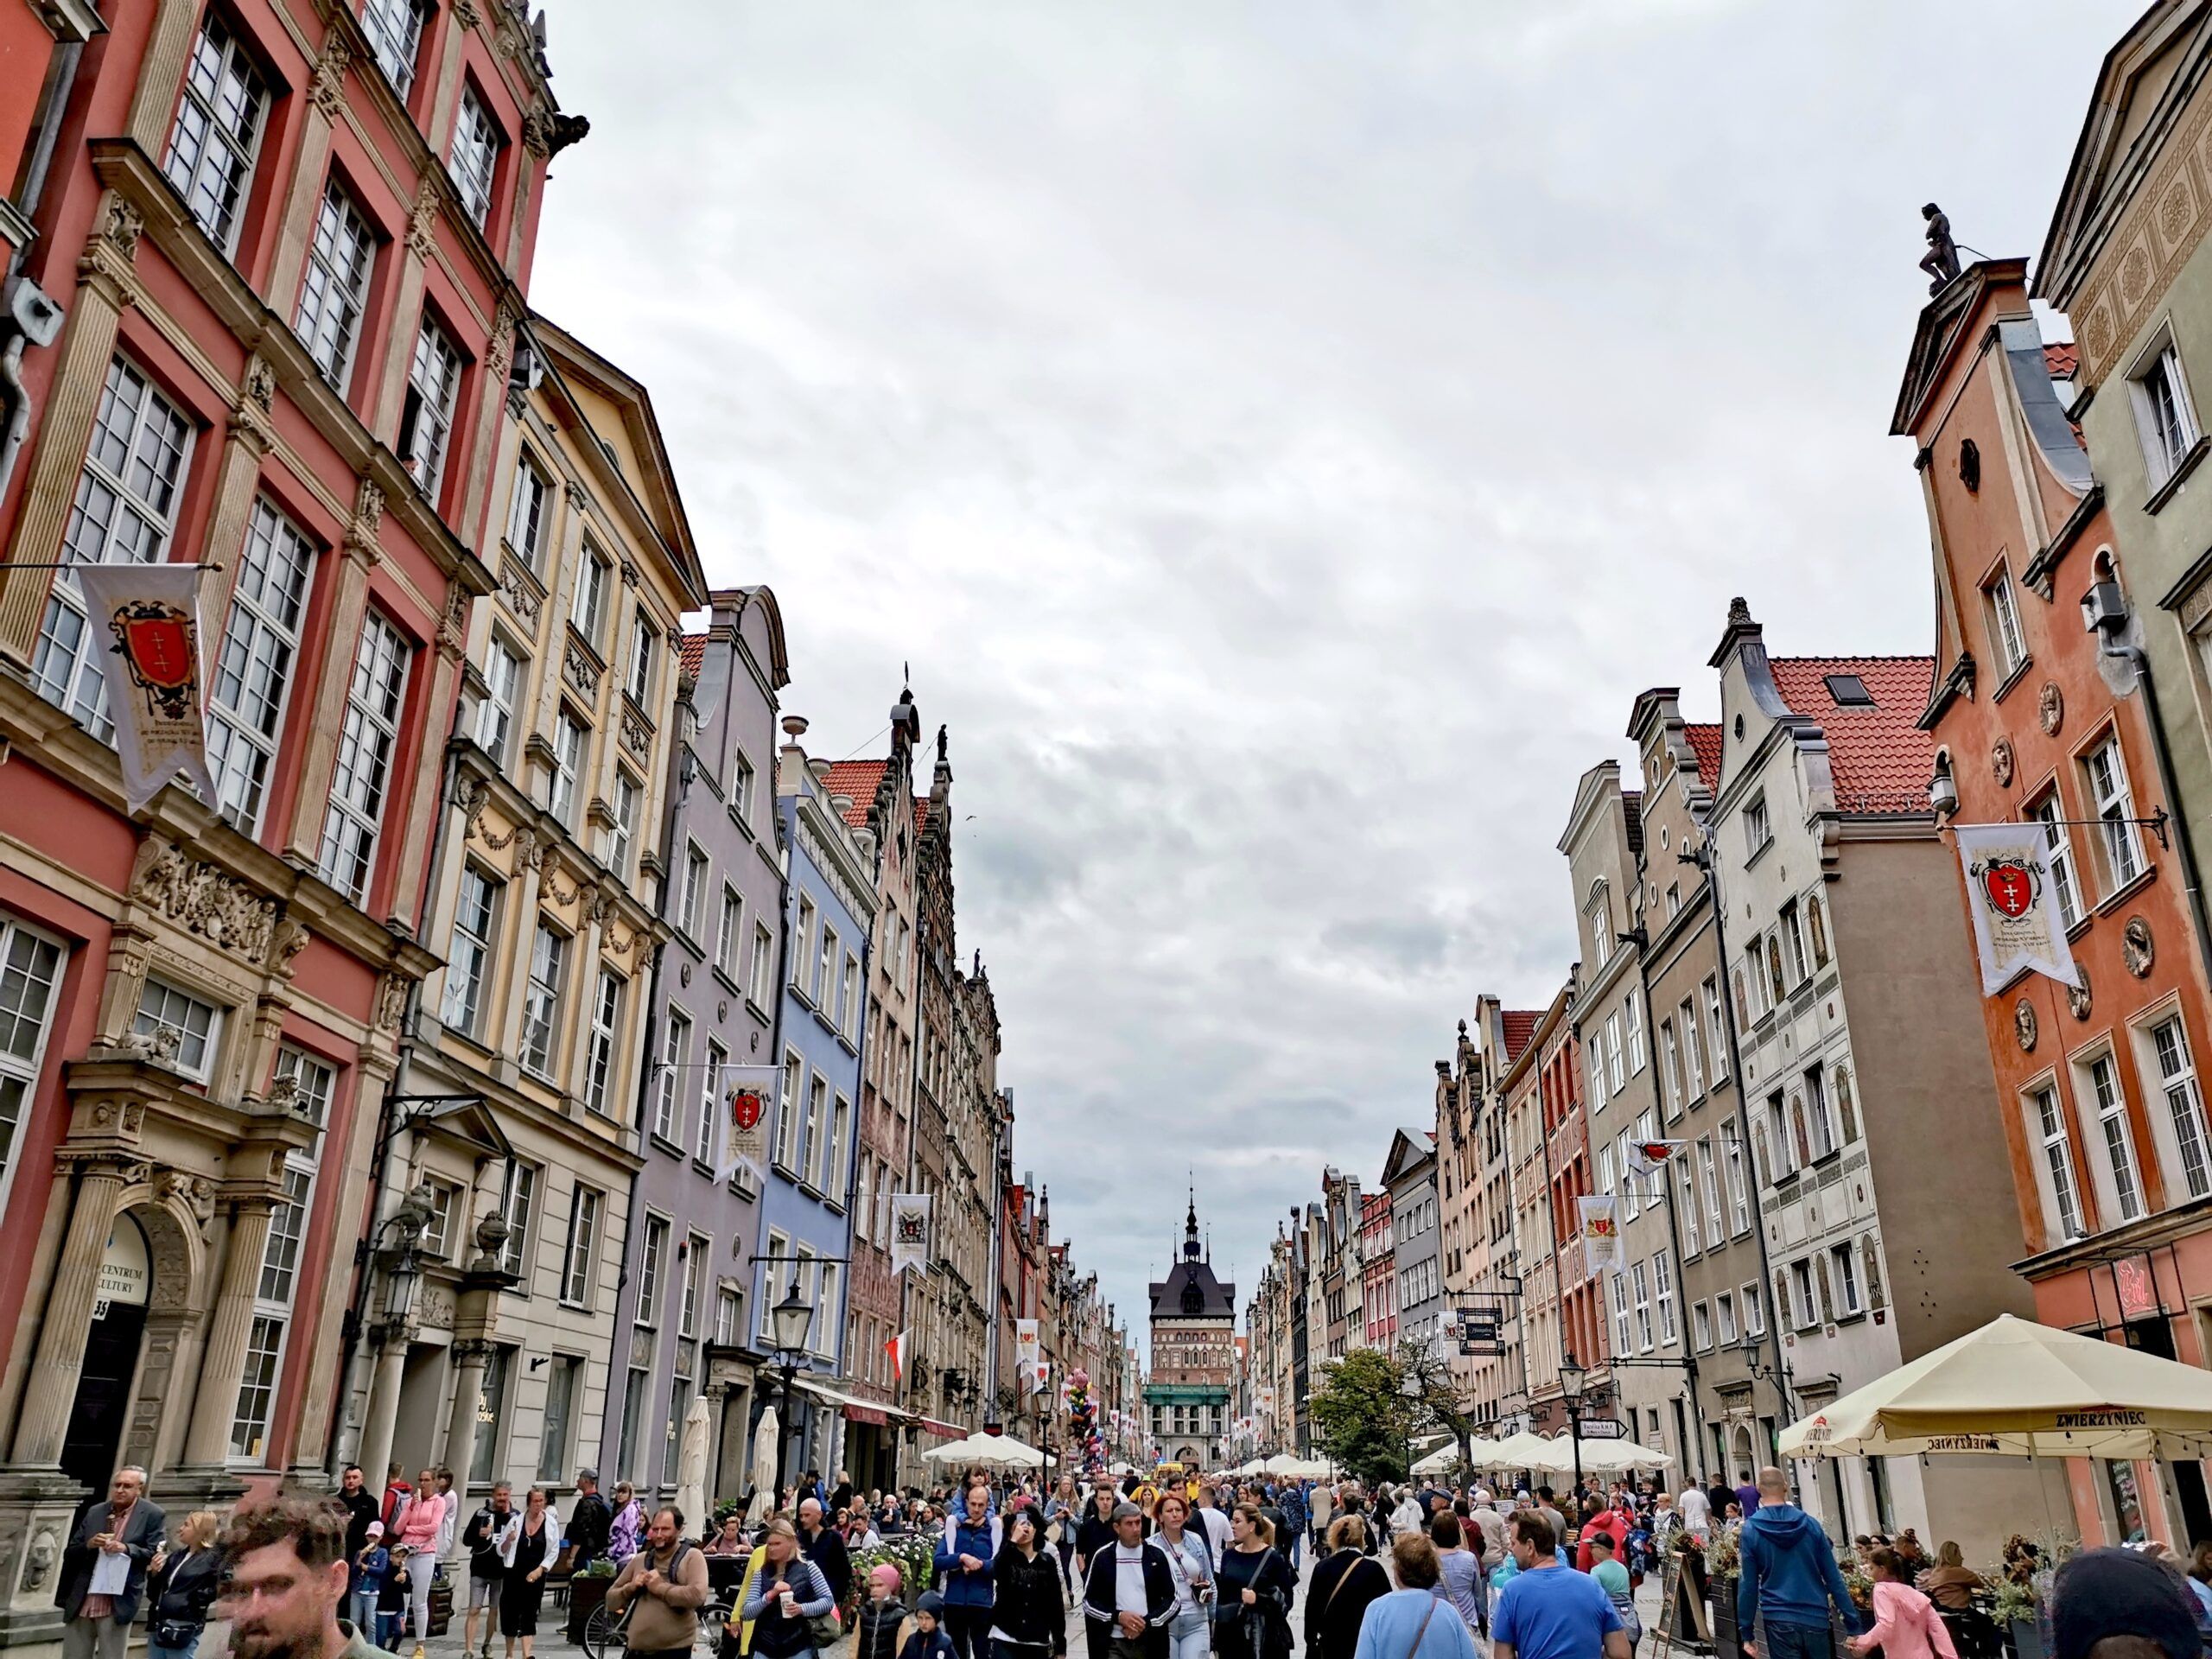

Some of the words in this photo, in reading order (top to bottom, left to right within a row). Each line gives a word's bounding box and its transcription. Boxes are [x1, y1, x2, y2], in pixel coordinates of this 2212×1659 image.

[101, 1264, 143, 1280] CENTRUM
[98, 1279, 133, 1293] ULTURY
[94, 1300, 108, 1316] 35
[2056, 1410, 2146, 1427] ZWIERZYNIEC
